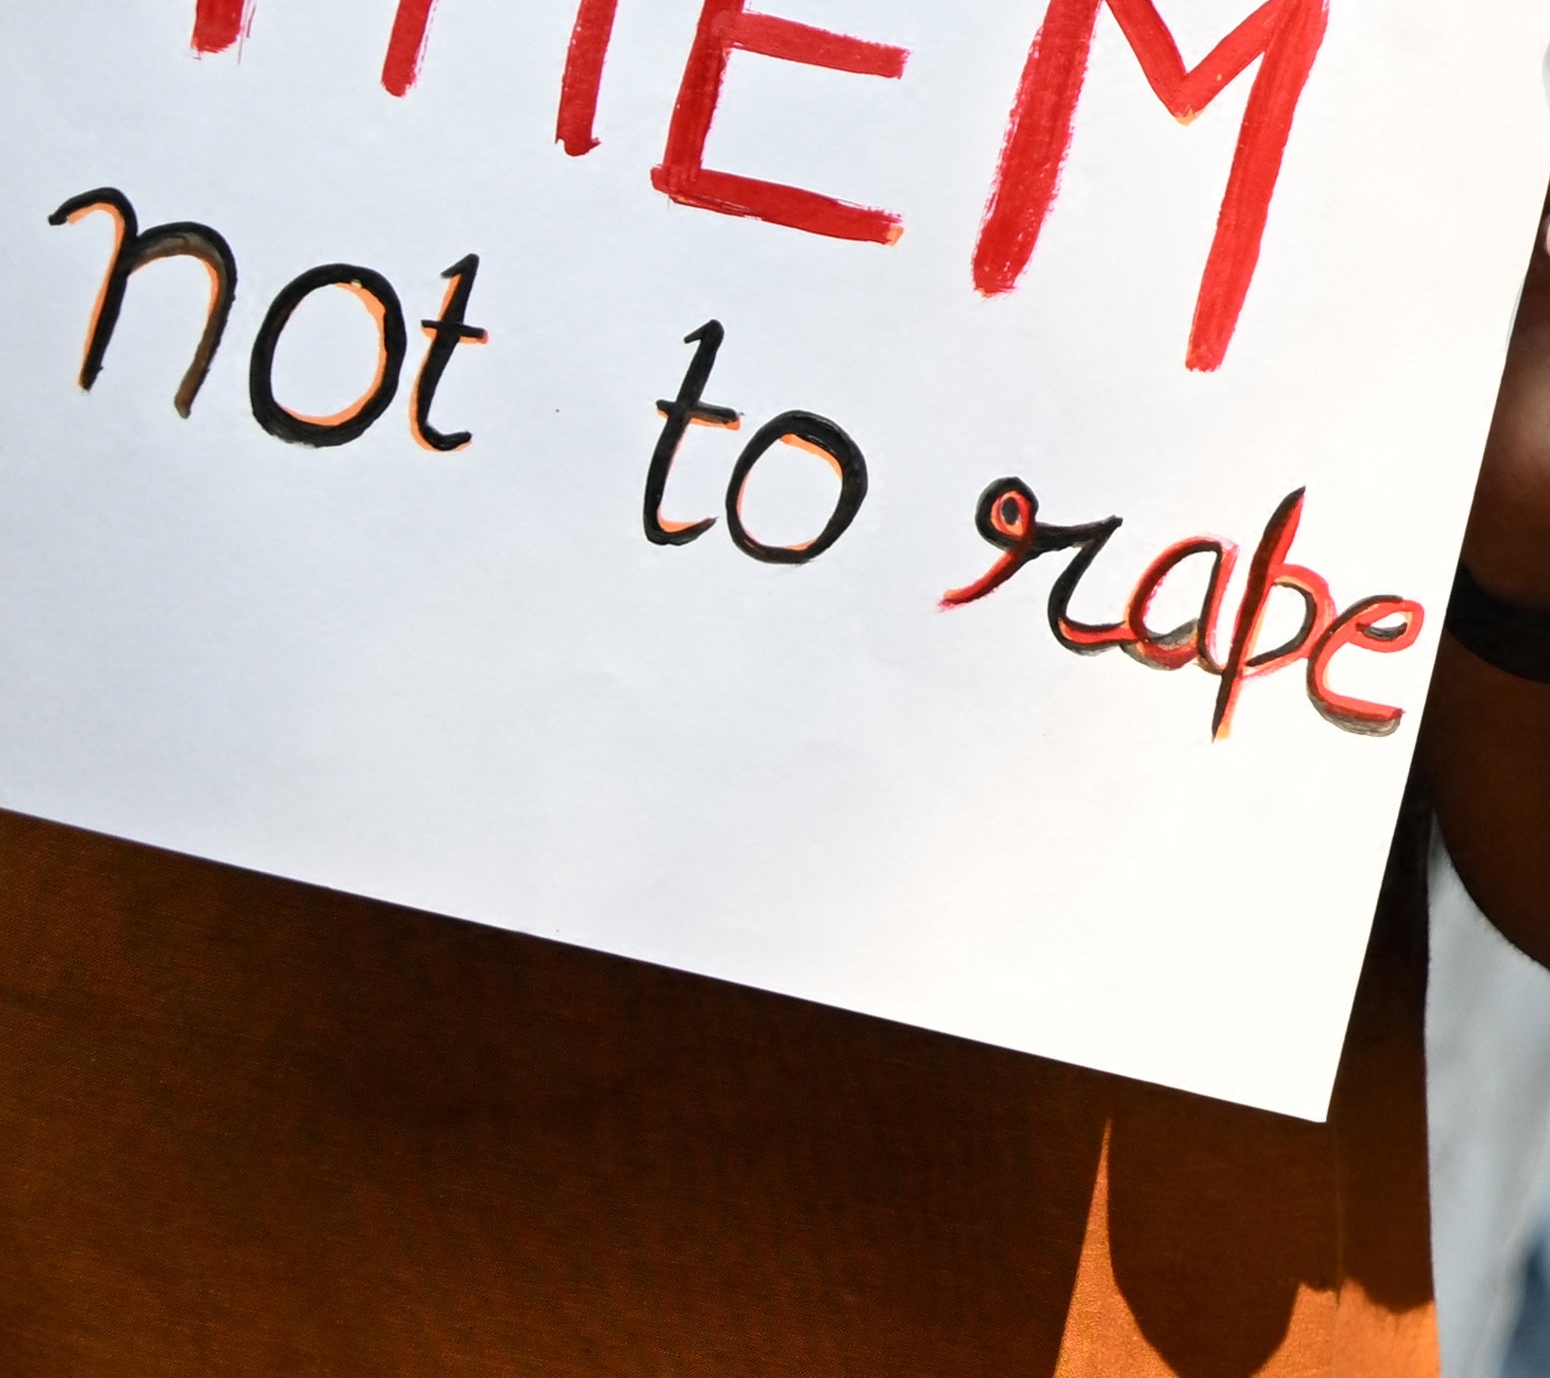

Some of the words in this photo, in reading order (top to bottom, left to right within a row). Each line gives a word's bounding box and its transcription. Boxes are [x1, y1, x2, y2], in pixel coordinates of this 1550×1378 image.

[48, 187, 490, 453] not
[641, 319, 870, 565] to
[940, 477, 1428, 748] rape
